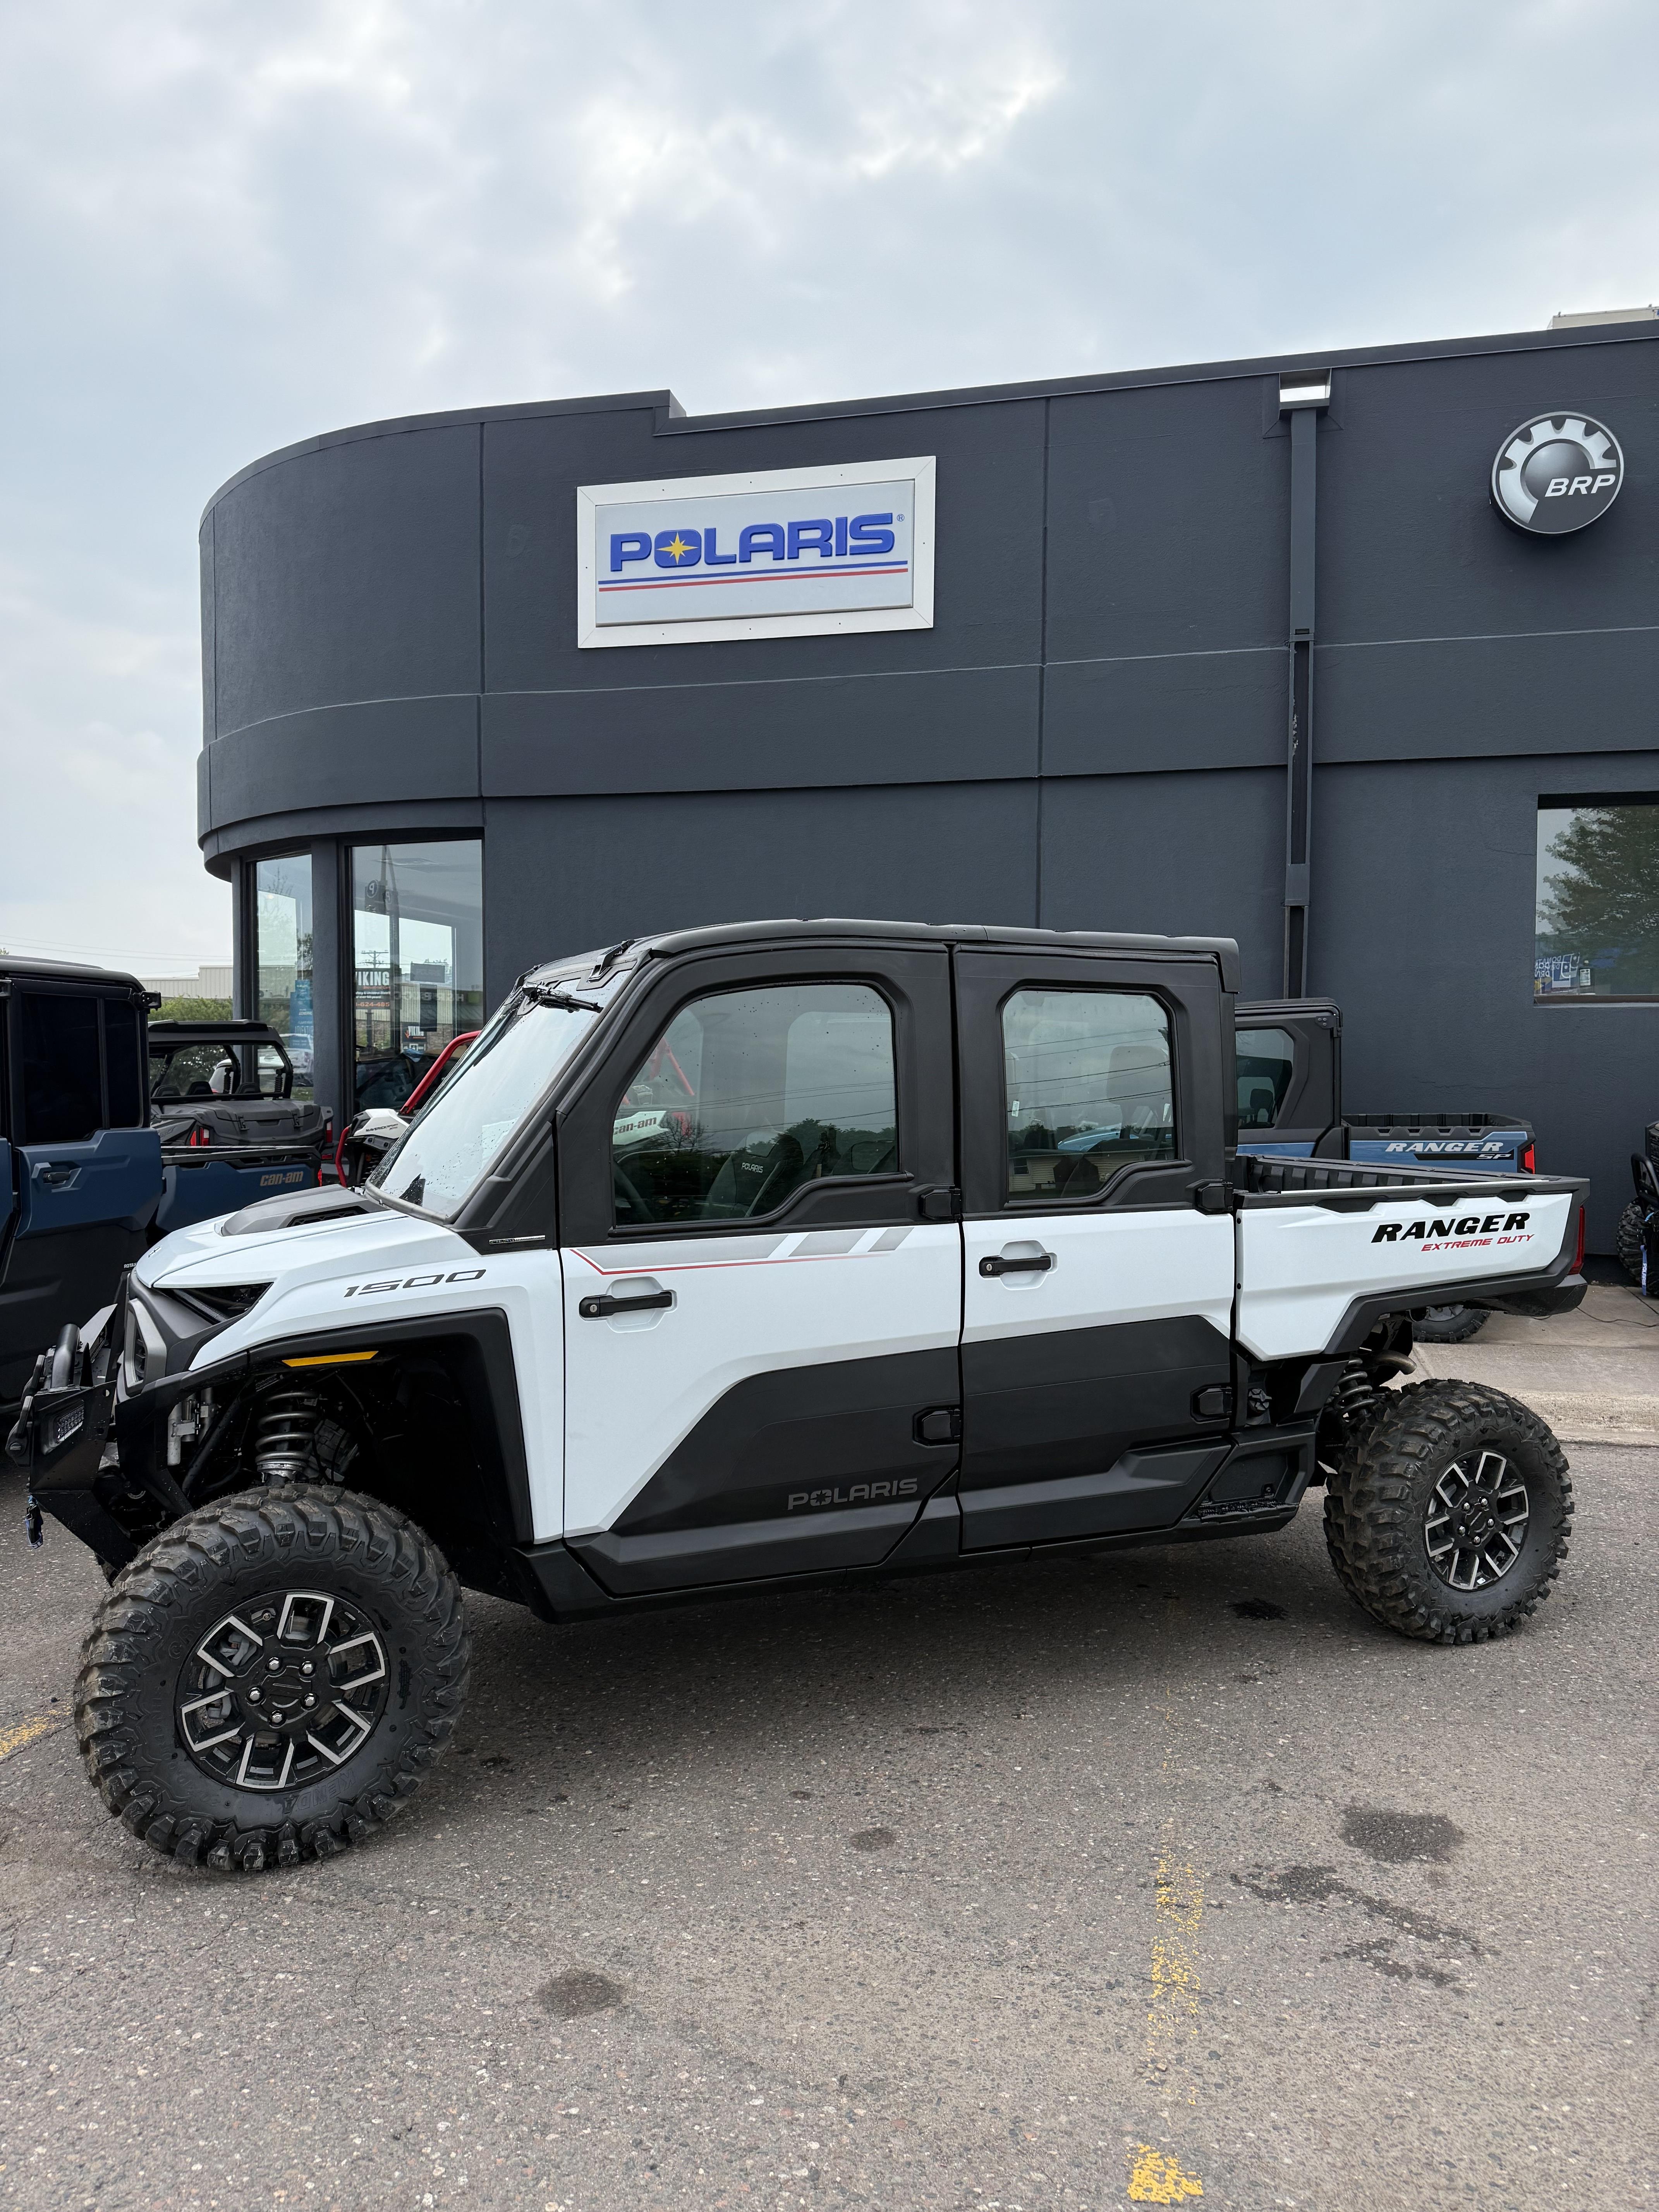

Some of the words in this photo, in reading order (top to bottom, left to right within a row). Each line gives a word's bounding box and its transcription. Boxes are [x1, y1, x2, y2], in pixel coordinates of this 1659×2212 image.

[1544, 474, 1616, 497] BRP
[610, 512, 895, 572] POLARIS
[1385, 1142, 1504, 1152] RANGER
[260, 1171, 304, 1187] can-am
[741, 1162, 764, 1174] POLARIS
[1370, 1212, 1530, 1243] RANGER
[1420, 1238, 1493, 1252] EXTREME
[1496, 1233, 1535, 1245] DUTY
[343, 1269, 486, 1298] 1500
[787, 1478, 918, 1510] POLARIS
[284, 1767, 356, 1814] KENDA
